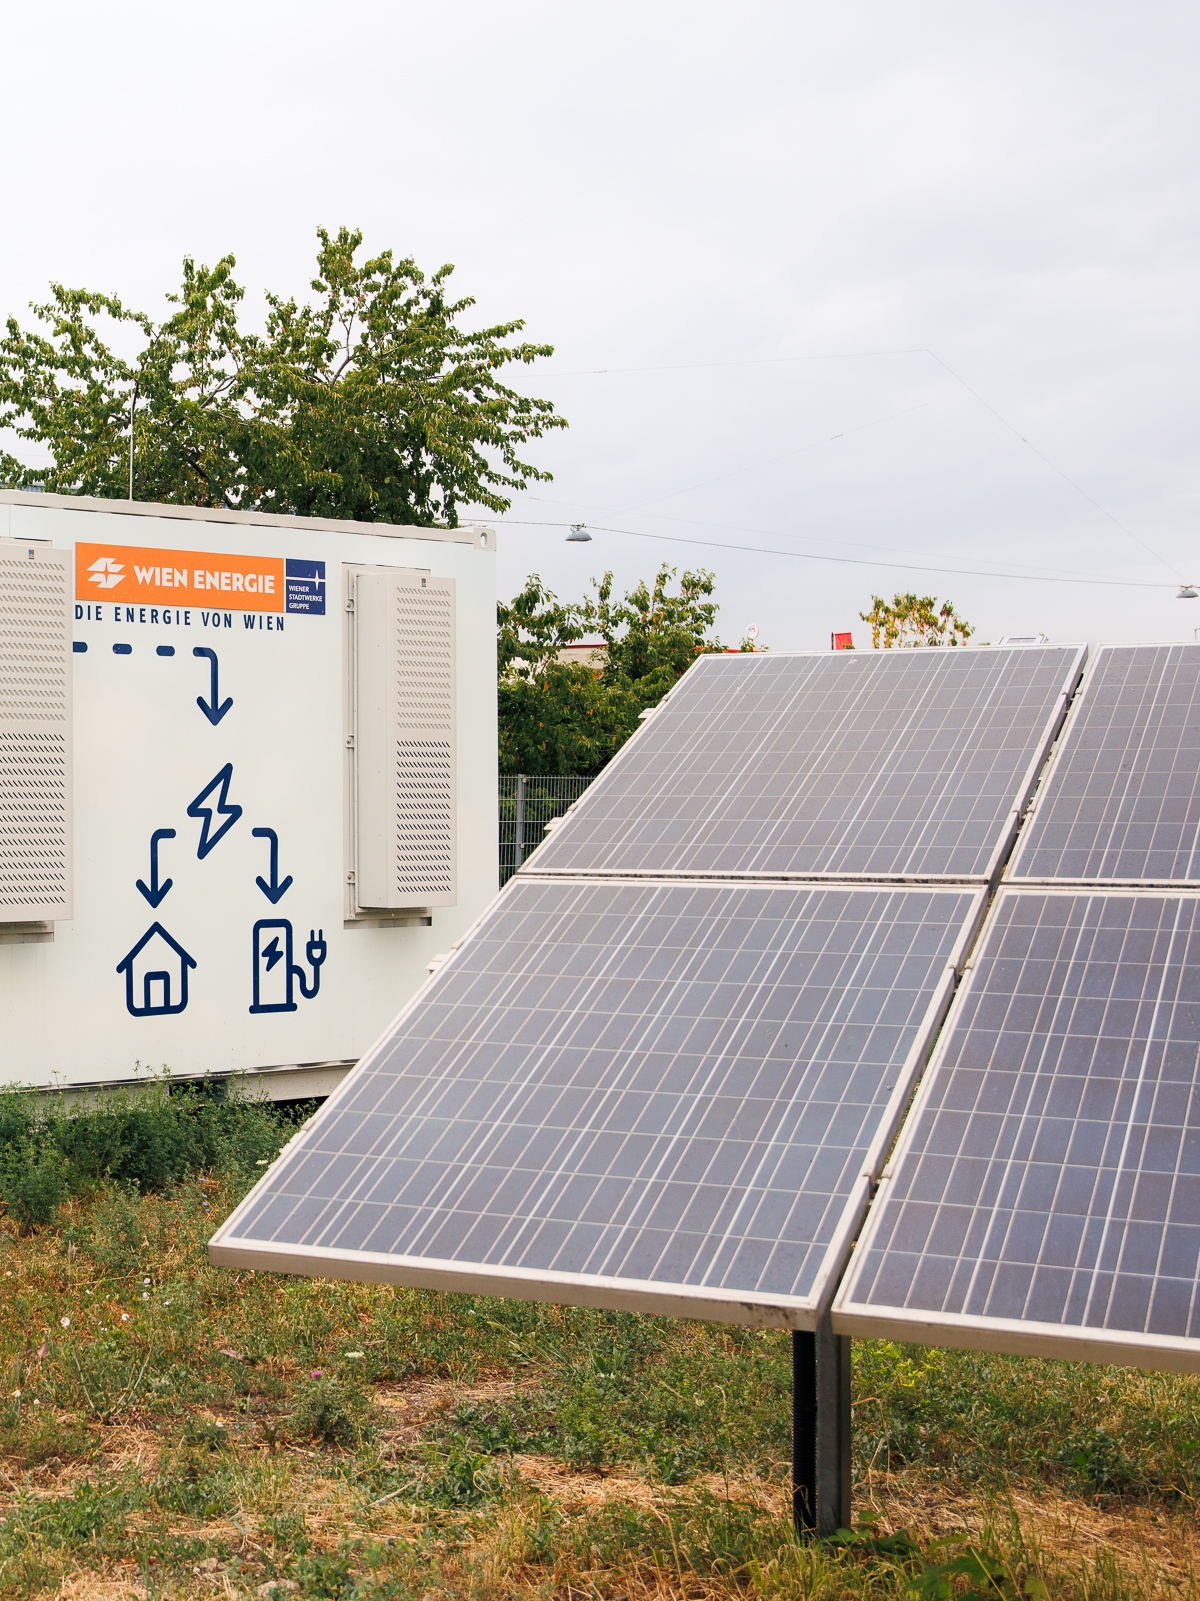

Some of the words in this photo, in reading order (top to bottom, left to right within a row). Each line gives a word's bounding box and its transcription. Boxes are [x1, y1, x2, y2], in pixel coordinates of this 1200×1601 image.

[133, 565, 188, 588] WIEN
[193, 569, 276, 594] ENERGIE
[288, 593, 323, 602] STADTWERKE
[288, 602, 310, 610] GRUPPE
[74, 604, 103, 621] DIE
[114, 606, 191, 626] ENERGIE
[201, 611, 232, 628] VON
[243, 614, 285, 632] WIEN
